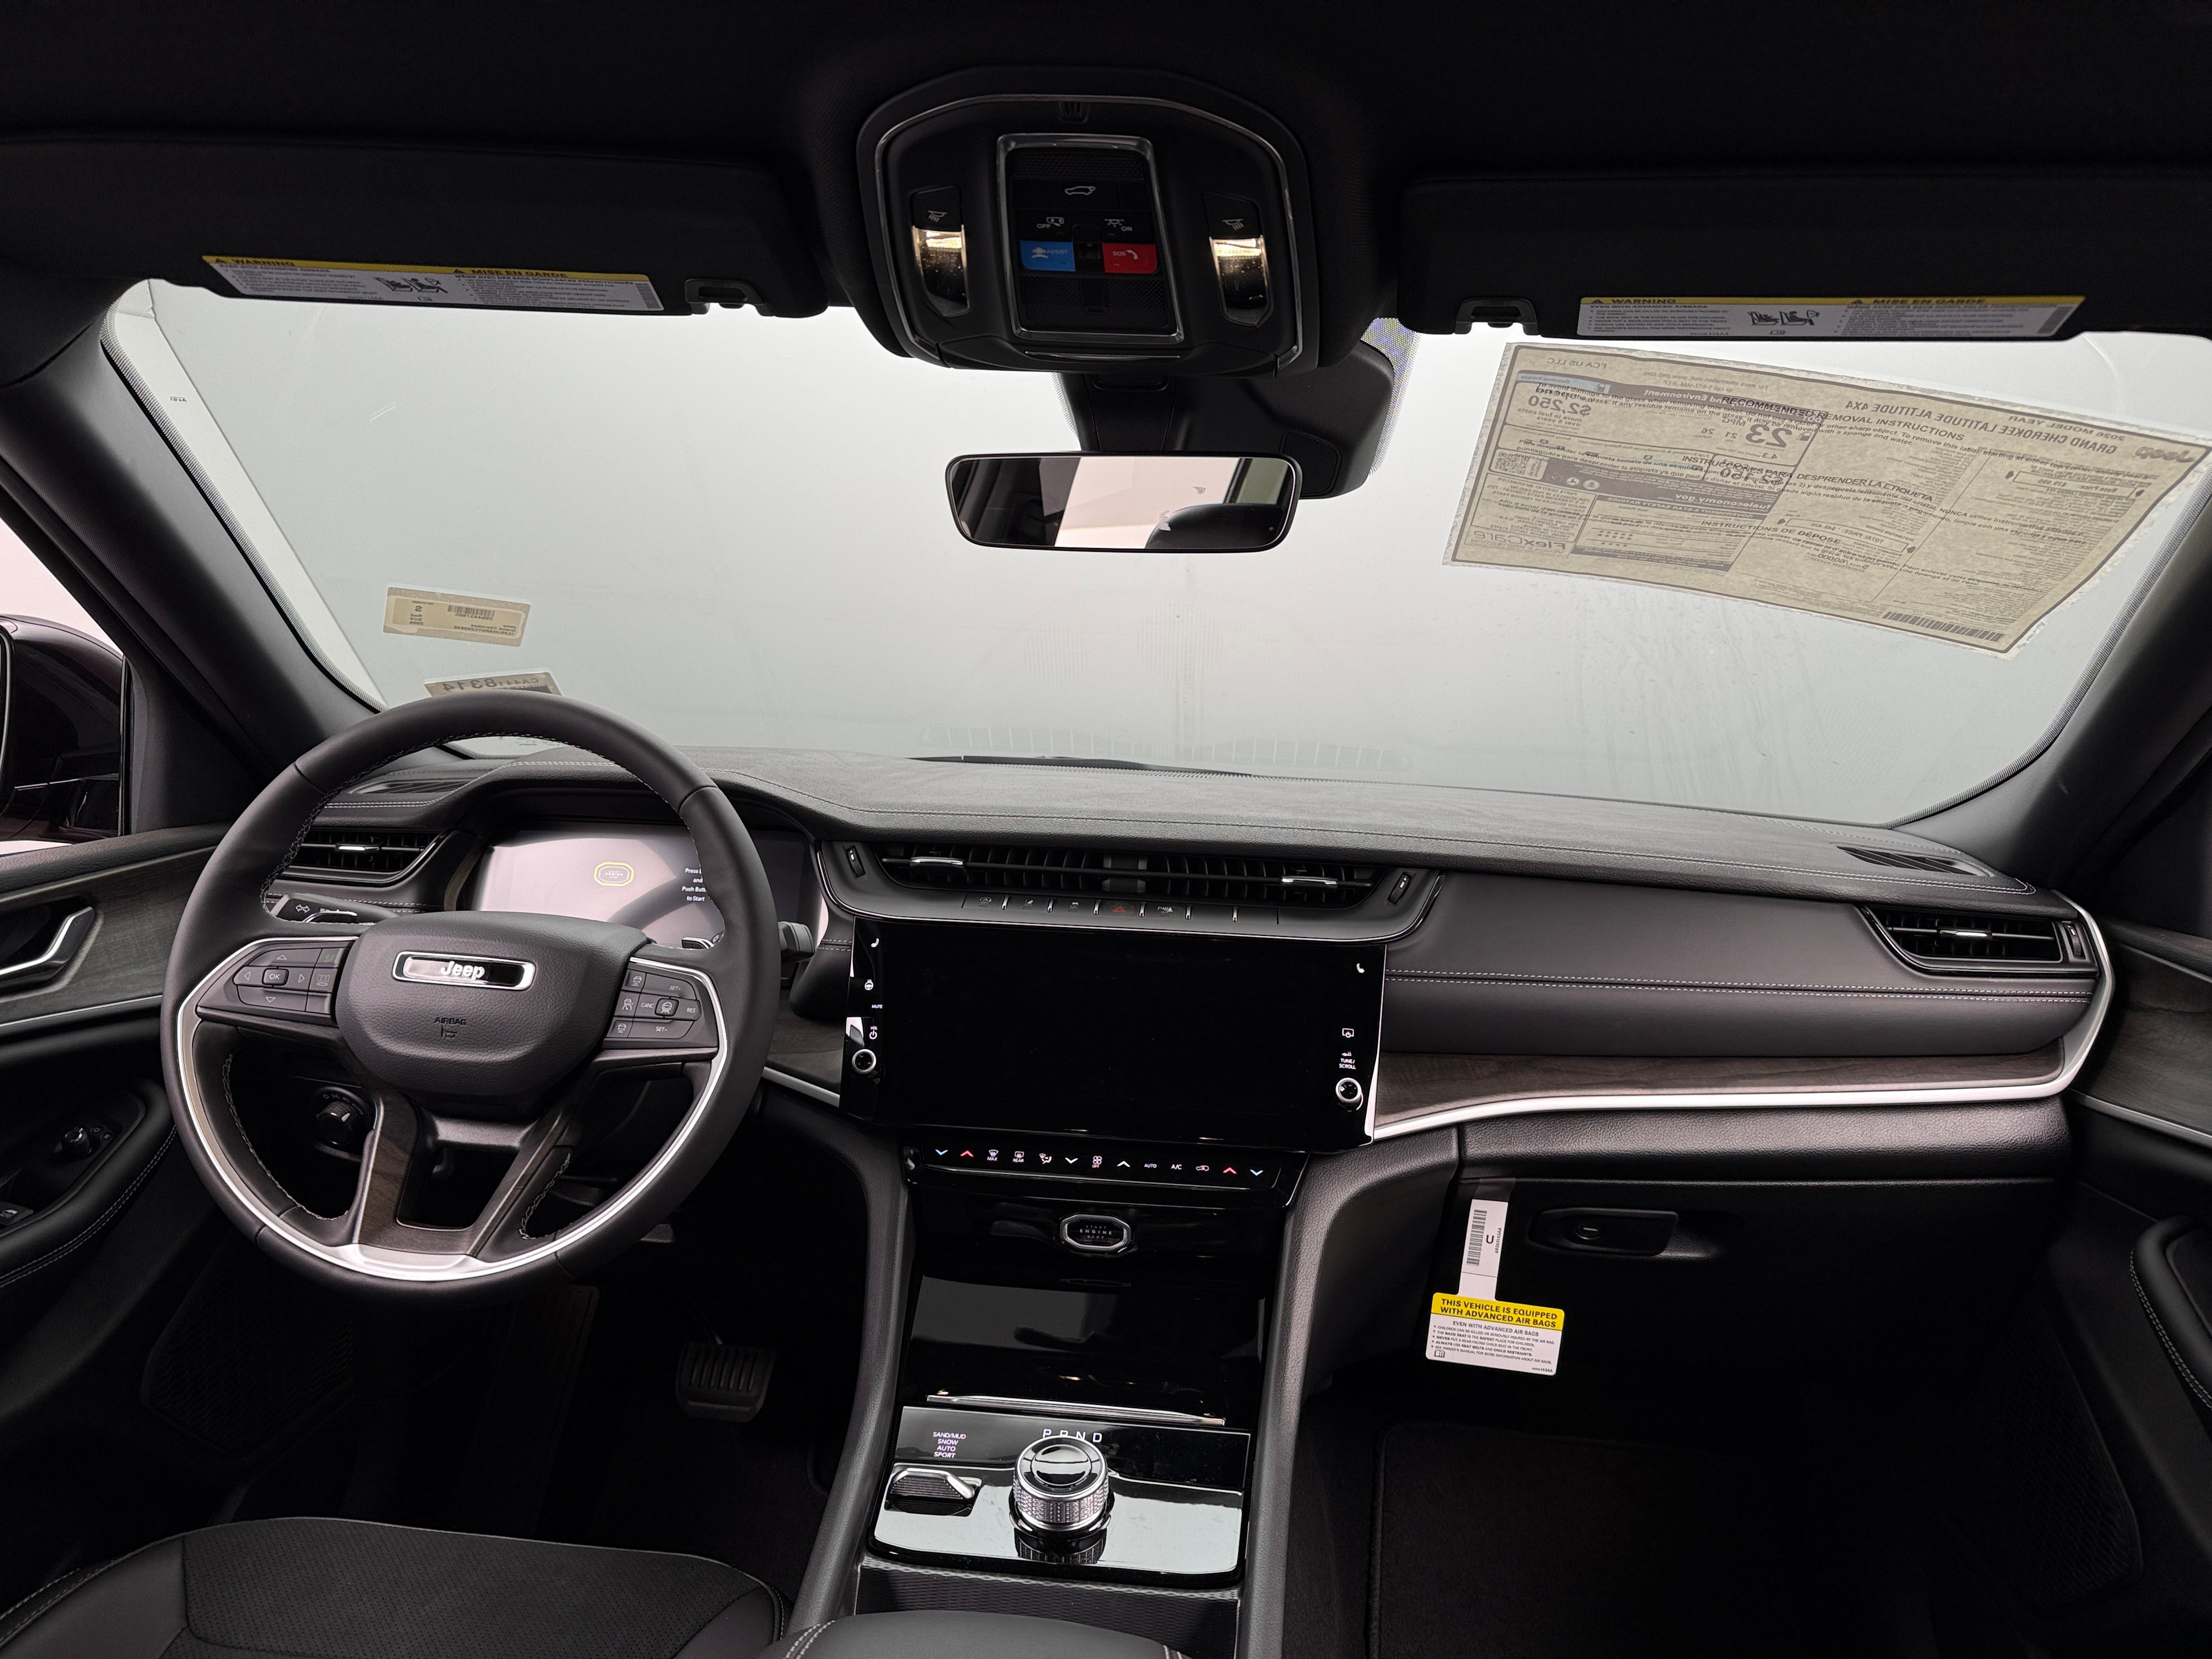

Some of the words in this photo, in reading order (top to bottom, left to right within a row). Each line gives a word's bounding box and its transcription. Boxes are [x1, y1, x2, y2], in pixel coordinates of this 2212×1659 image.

[1722, 396, 1814, 418] RECOMMENDED
[1815, 411, 1872, 425] REMOVAL
[1876, 417, 1965, 442] INSTRUCTIONS
[1843, 430, 1872, 438] sponge
[1891, 437, 1912, 446] water.
[1912, 436, 1942, 445] remove
[1579, 458, 1619, 469] desprender
[1796, 473, 1867, 486] DESPRENDER
[1883, 483, 1932, 501] ETIQUETA
[1940, 507, 1967, 517] NUNCA
[1701, 521, 1778, 532] INSTRUCTIONS
[1797, 531, 1841, 545] DÉPOSE
[440, 961, 485, 980] Jeep
[434, 1017, 466, 1025] AIRBAG
[1486, 1234, 1494, 1244] U
[1441, 1298, 1462, 1307] THIS
[1464, 1301, 1501, 1312] VEHICLE
[1514, 1308, 1557, 1320] EQUIPPED
[1441, 1306, 1463, 1315] WITH
[1465, 1310, 1514, 1322] ADVANCED
[1533, 1319, 1556, 1328] BAGS
[1483, 1325, 1513, 1333] ADVANCED
[1043, 1429, 1052, 1438] P
[1076, 1431, 1086, 1440] N
[1093, 1432, 1102, 1442] D
